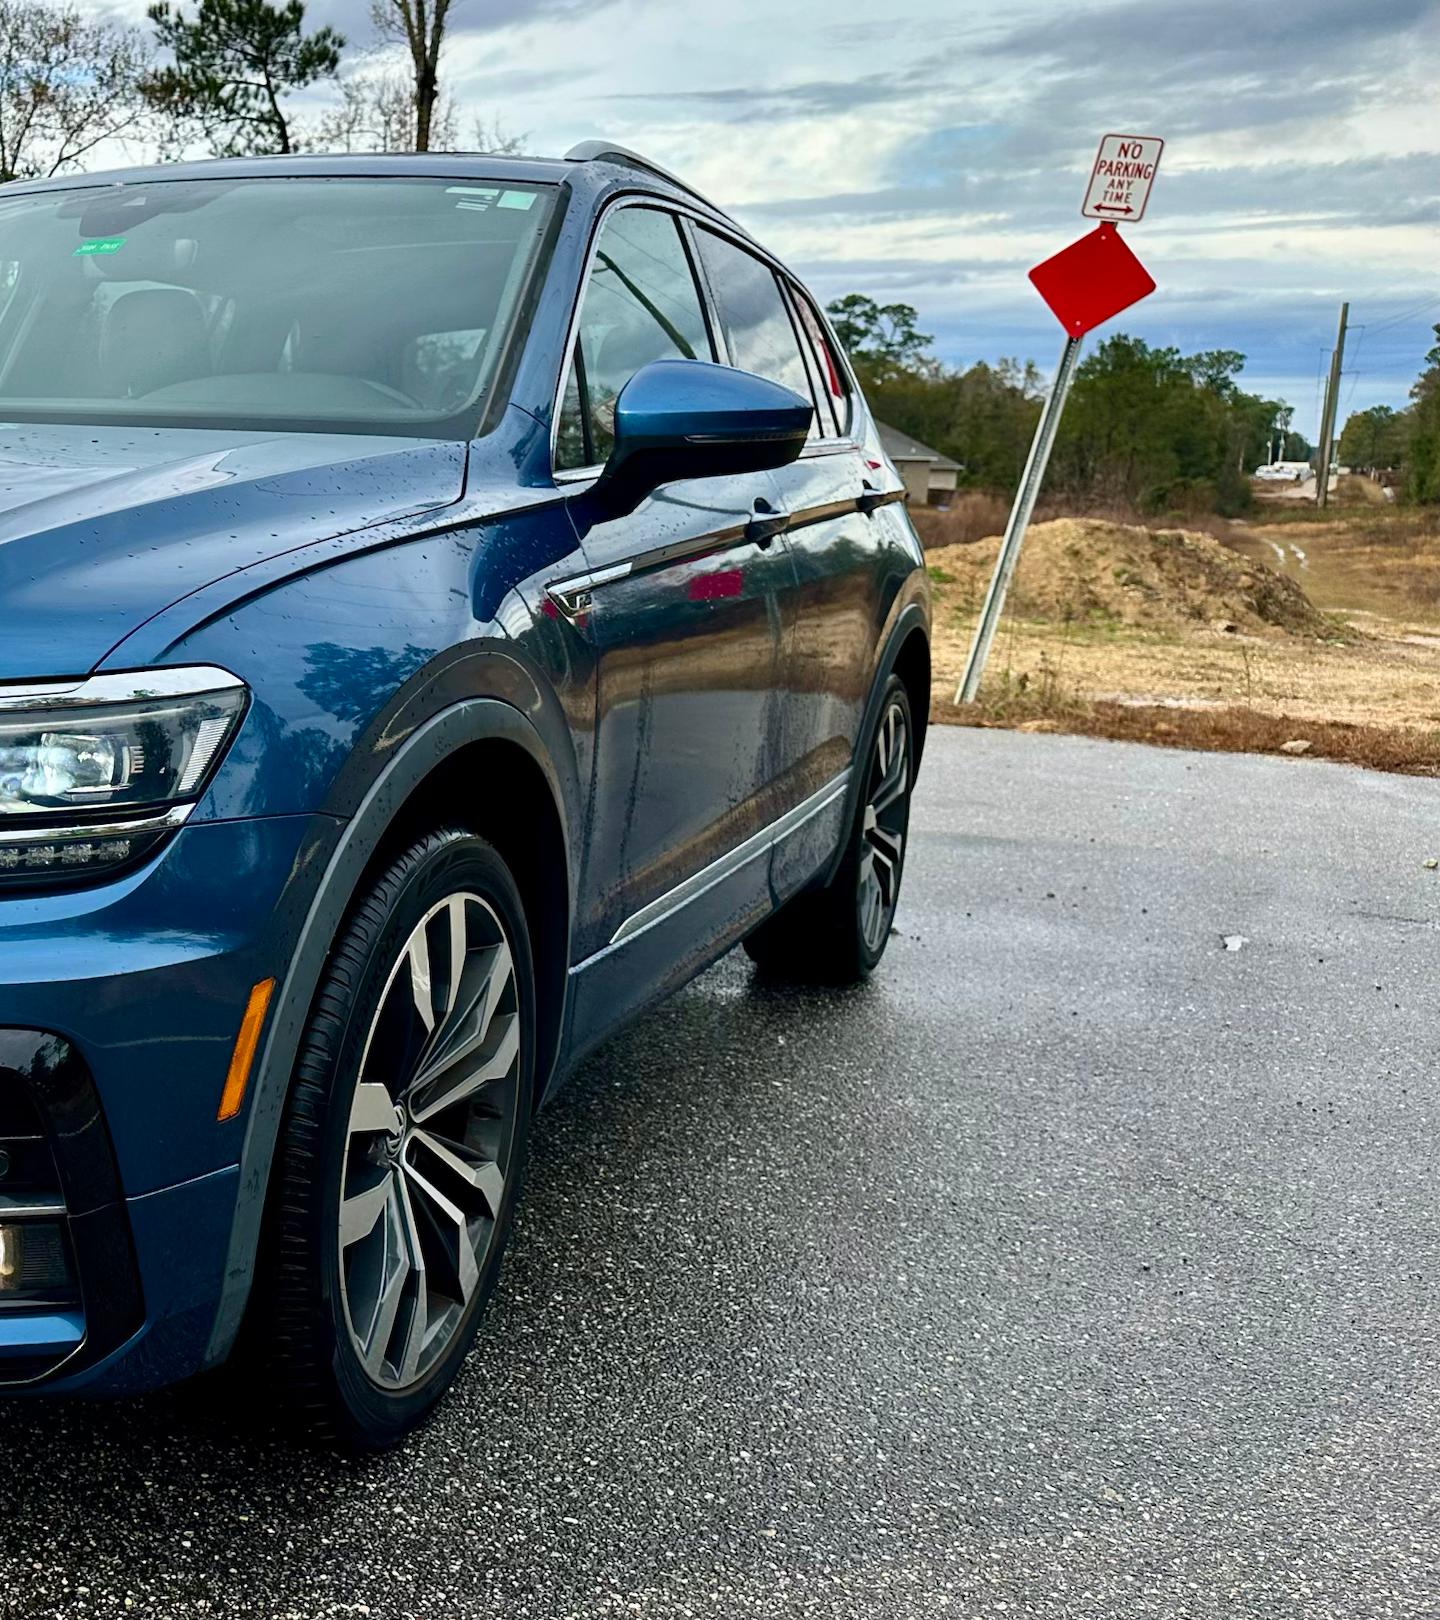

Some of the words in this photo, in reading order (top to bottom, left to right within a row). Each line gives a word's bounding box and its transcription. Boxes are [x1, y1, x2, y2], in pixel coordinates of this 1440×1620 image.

[1117, 142, 1143, 160] NO
[1097, 159, 1153, 180] PARKING
[1107, 178, 1134, 191] ANY
[1102, 190, 1133, 204] TIME
